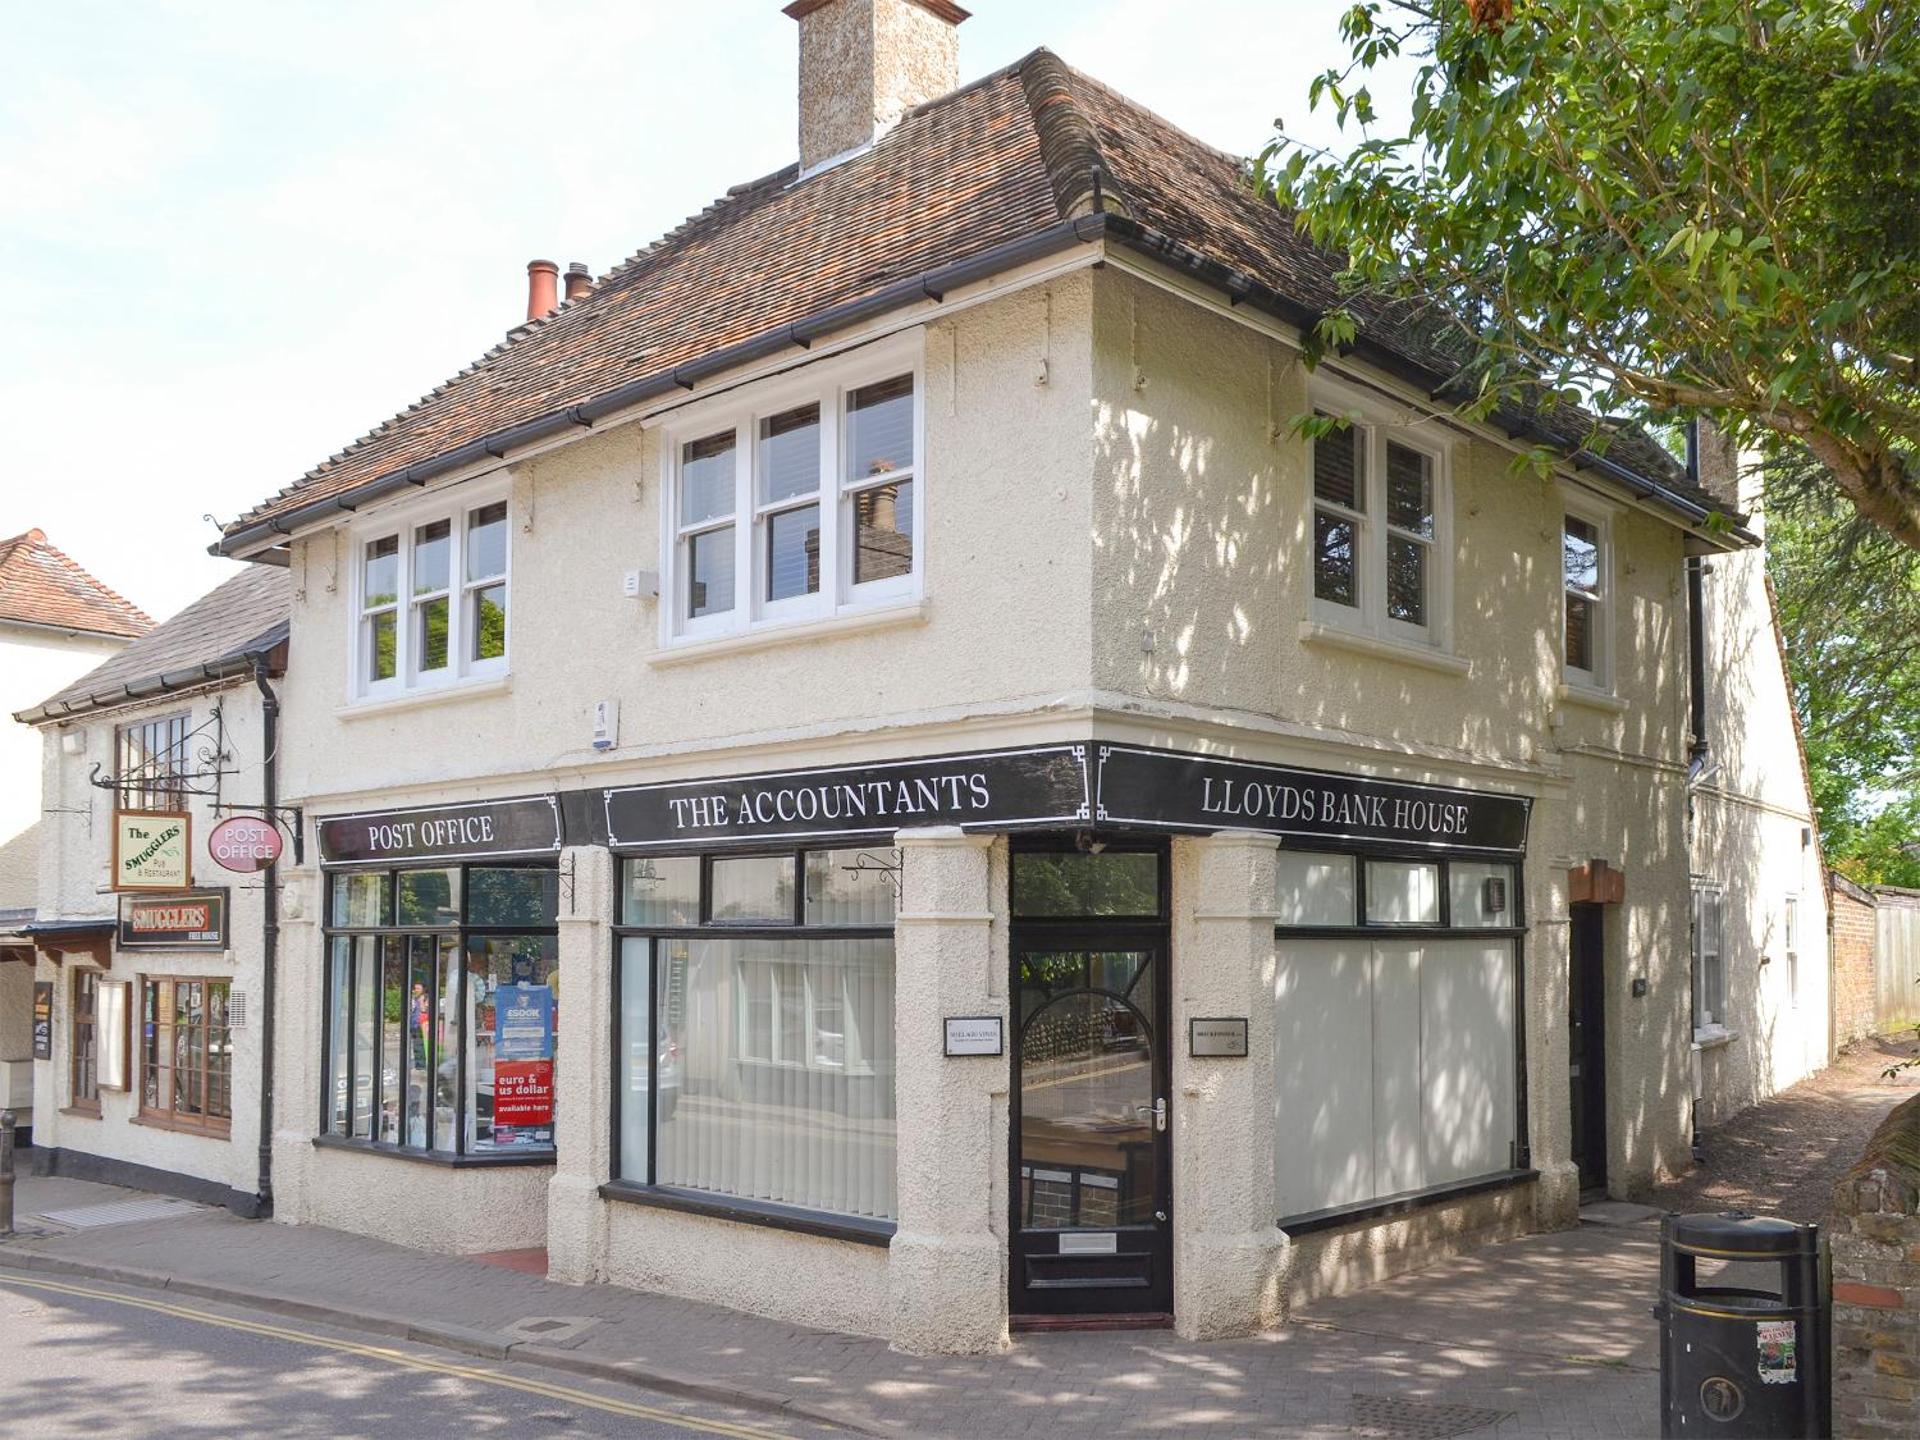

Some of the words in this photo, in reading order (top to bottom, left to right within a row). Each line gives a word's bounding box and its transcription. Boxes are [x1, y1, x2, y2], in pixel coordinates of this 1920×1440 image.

[669, 795, 729, 829] THE
[737, 773, 990, 825] ACCOUNTANTS
[1202, 777, 1315, 822] LLOYDS
[1320, 790, 1387, 828] BANK
[1393, 799, 1469, 835] HOUSE
[128, 828, 150, 839] The
[224, 828, 267, 842] POST
[368, 822, 415, 851] POST
[420, 815, 494, 846] OFFICE
[125, 825, 180, 870] SMUGGLERS
[217, 845, 273, 860] OFFICE
[132, 908, 204, 930] SMUGGLERS
[498, 1075, 525, 1085] euro
[528, 1074, 537, 1084] &
[498, 1087, 513, 1095] us
[515, 1084, 549, 1095] dollar
[498, 1104, 531, 1112] available
